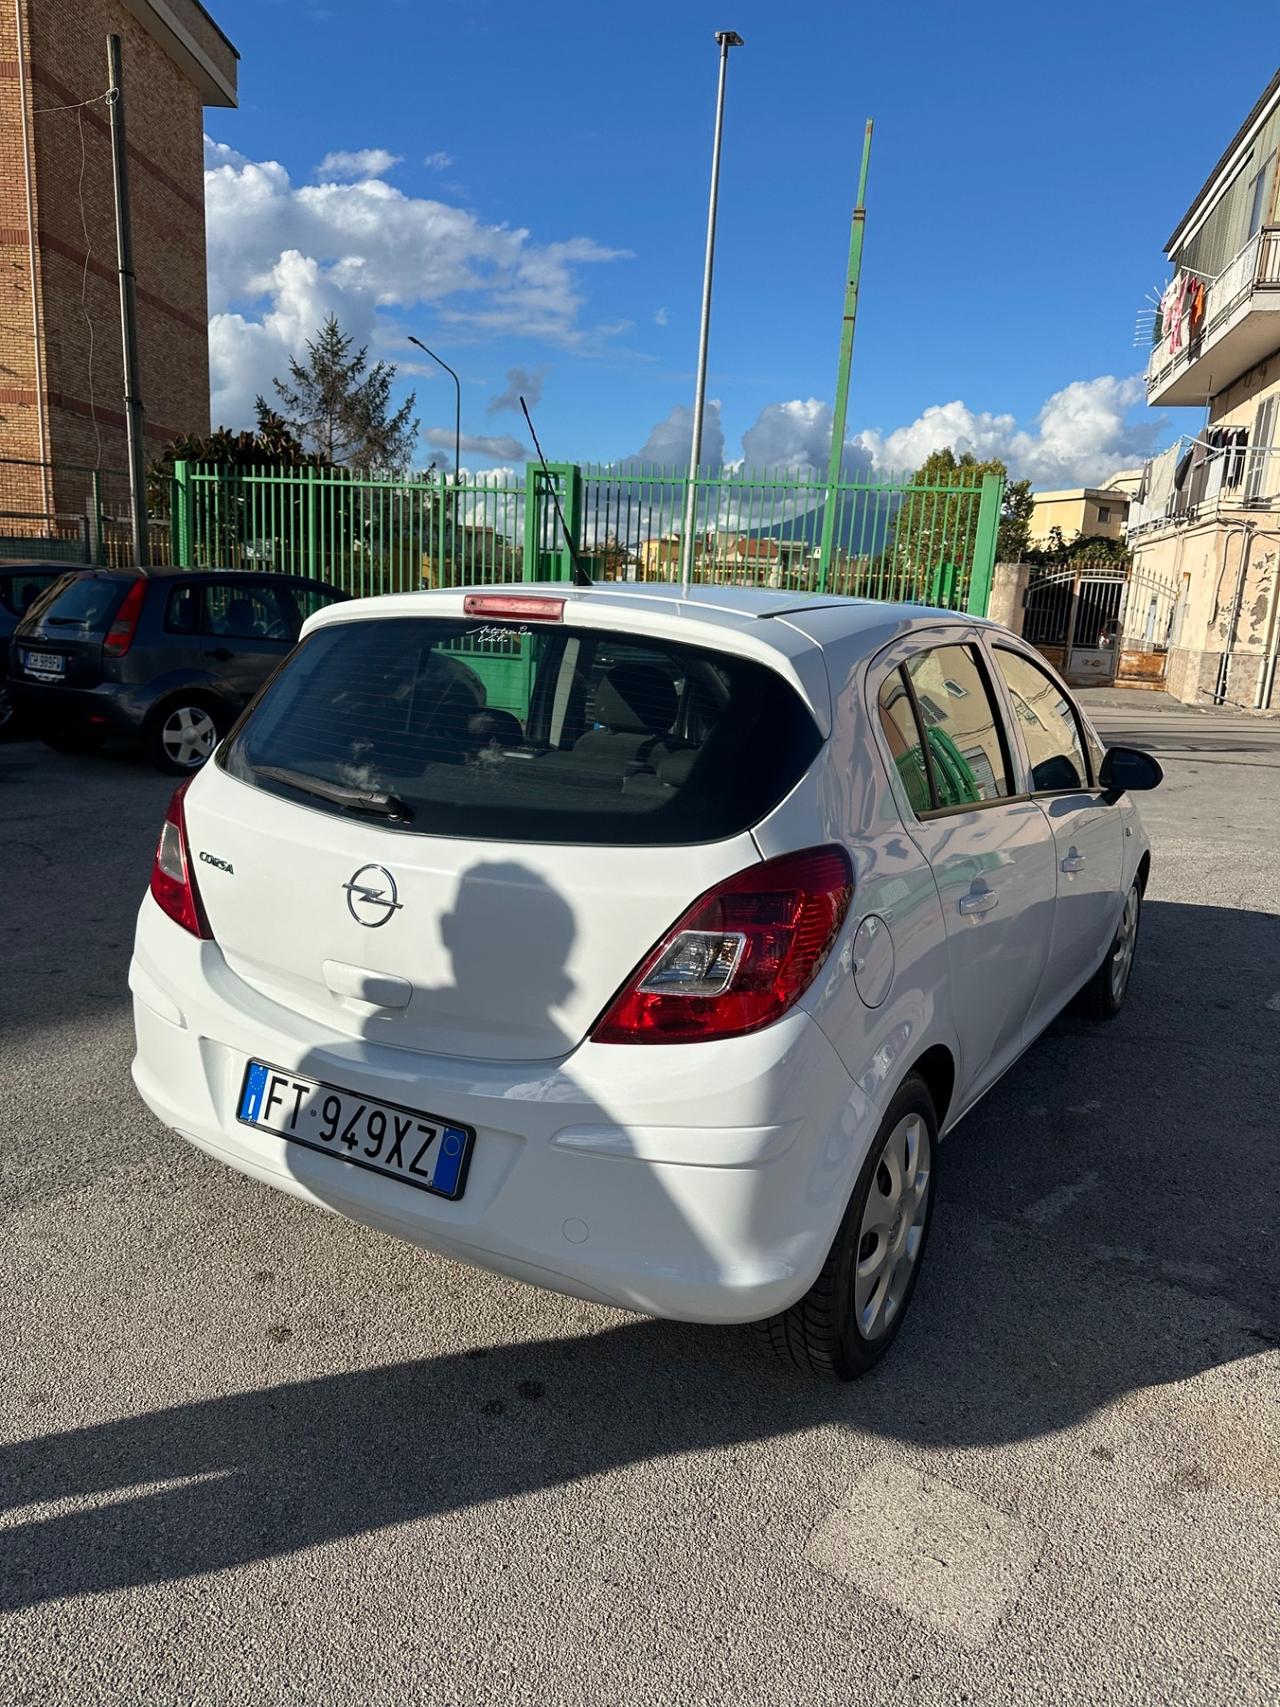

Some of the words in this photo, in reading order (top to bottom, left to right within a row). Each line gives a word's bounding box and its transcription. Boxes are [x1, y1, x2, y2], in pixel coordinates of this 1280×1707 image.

[199, 851, 234, 875] CORSA
[263, 1076, 310, 1130] FT
[319, 1095, 437, 1178] 949XZ
